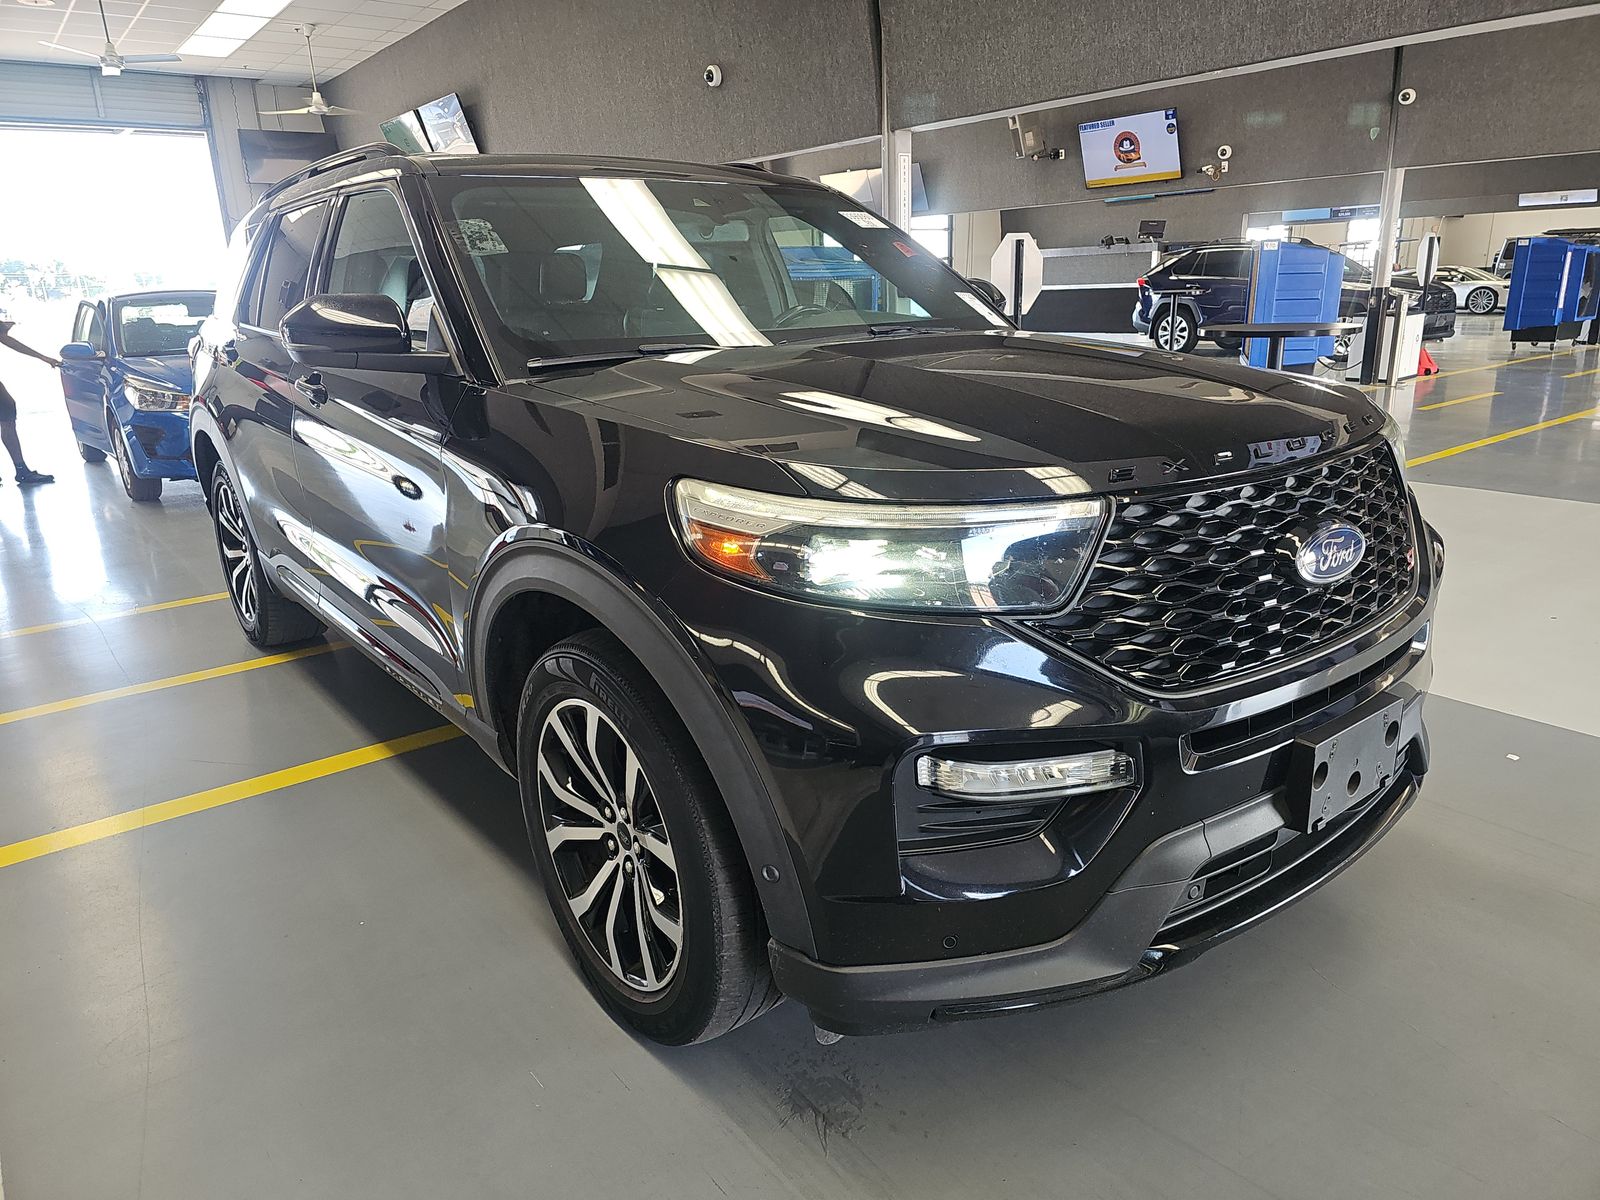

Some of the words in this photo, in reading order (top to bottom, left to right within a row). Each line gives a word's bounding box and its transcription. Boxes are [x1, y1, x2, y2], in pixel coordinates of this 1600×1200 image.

[1080, 122, 1100, 131] FEATURED
[1100, 120, 1115, 129] SELLER
[1108, 414, 1375, 483] EXPLORER
[693, 507, 767, 528] EXPLORER
[1319, 536, 1356, 571] Ford
[589, 672, 633, 729] PIRELLI
